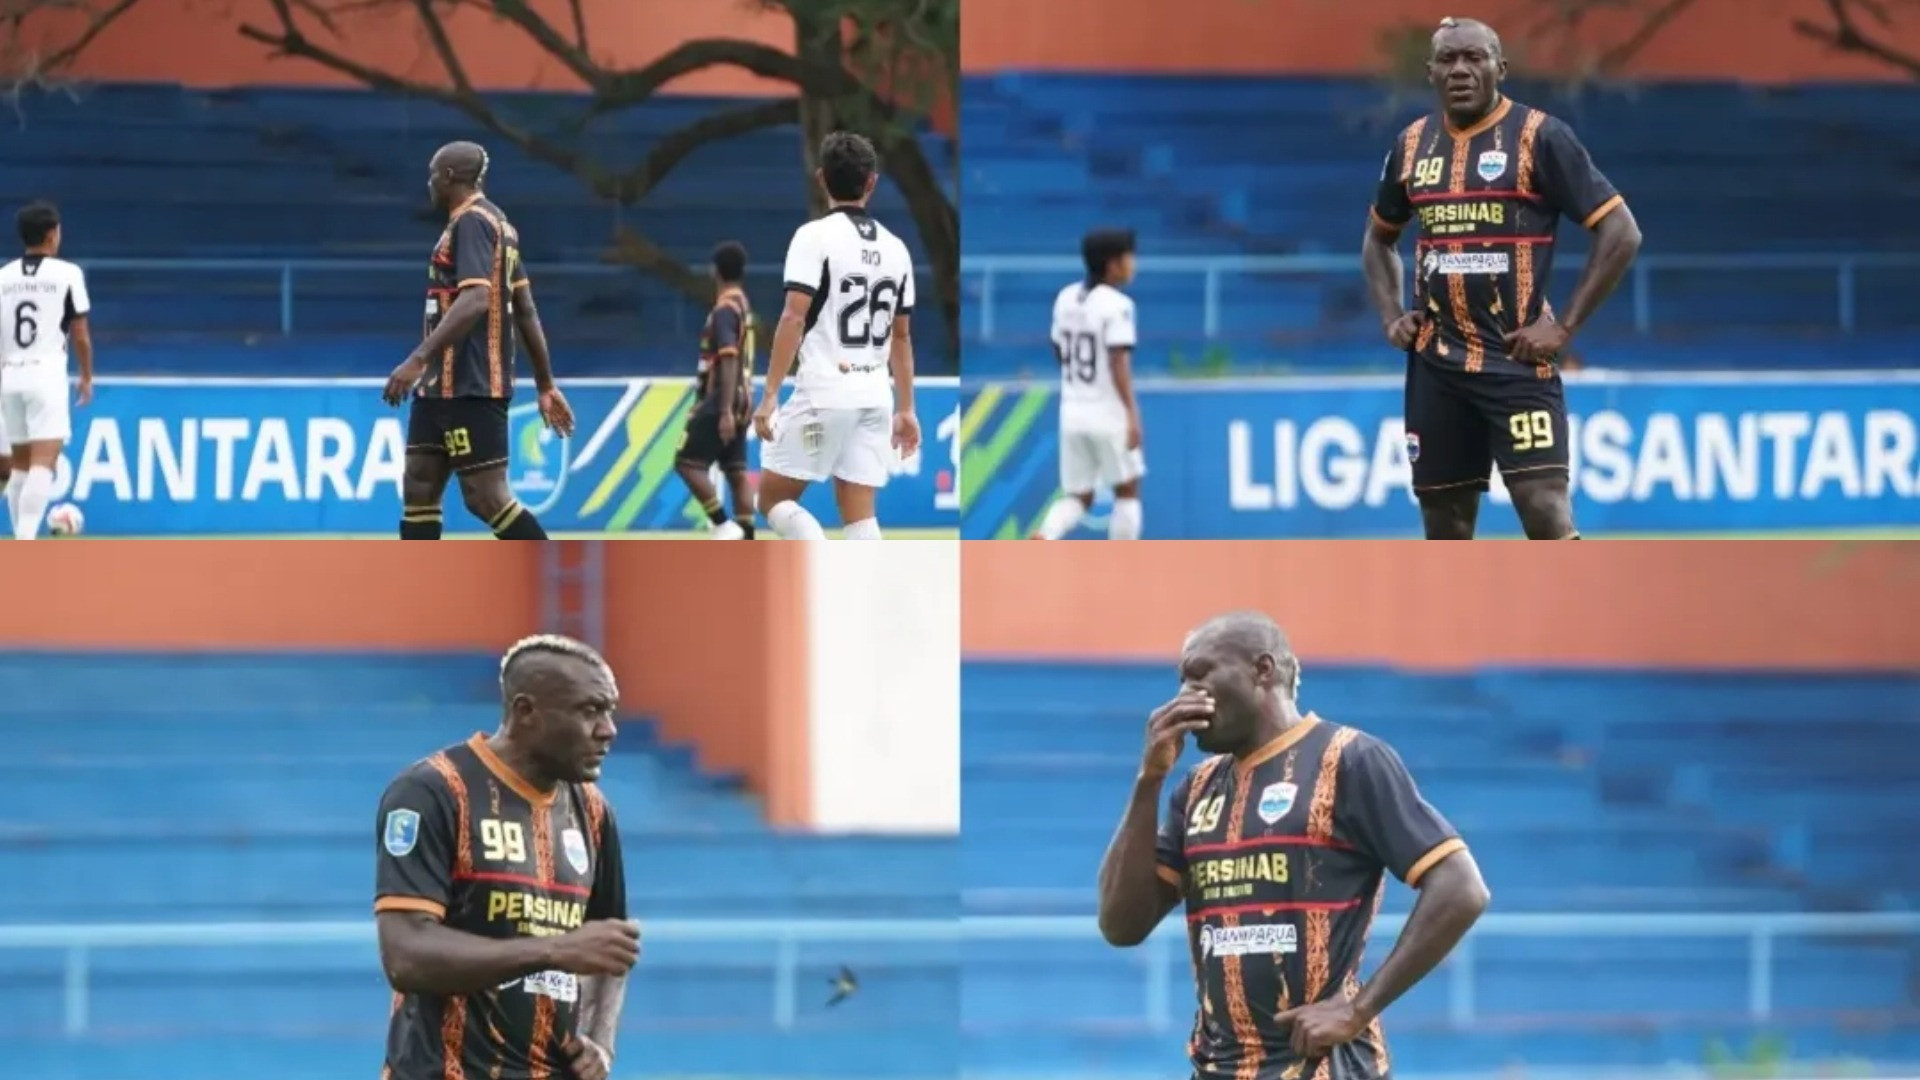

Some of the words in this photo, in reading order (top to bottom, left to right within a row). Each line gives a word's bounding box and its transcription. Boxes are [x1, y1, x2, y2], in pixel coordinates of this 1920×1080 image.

[1413, 157, 1444, 187] 99
[14, 301, 38, 349] 6
[839, 273, 898, 350] 26
[1509, 409, 1554, 451] 99
[1228, 416, 1419, 511] LIGA
[1489, 410, 1920, 503] SANTAR
[1187, 794, 1226, 836] 99
[480, 818, 527, 863] 99
[487, 890, 586, 928] PERSINA
